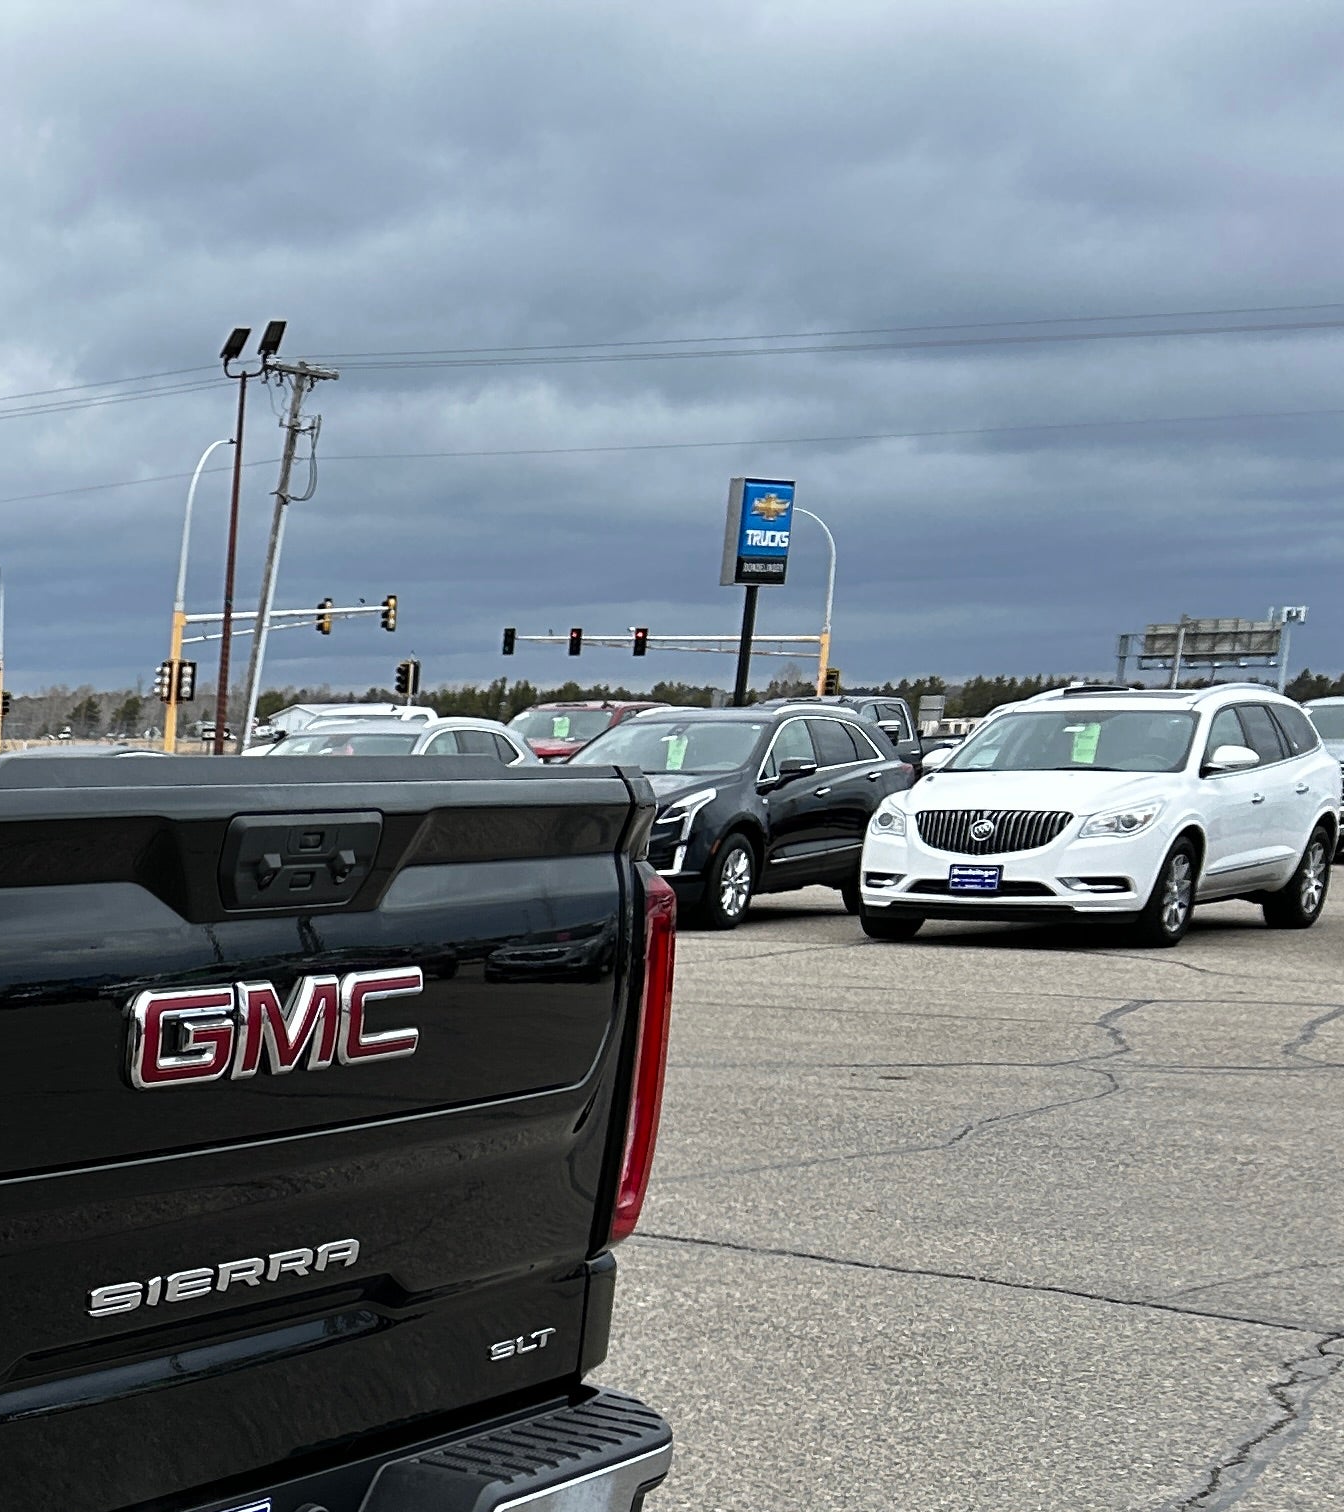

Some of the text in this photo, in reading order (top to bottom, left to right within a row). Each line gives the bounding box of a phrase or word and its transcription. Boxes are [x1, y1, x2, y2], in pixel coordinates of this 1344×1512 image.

[746, 529, 789, 547] TRUCKS
[126, 966, 424, 1092] GMC
[88, 1238, 361, 1318] SIERRA
[489, 1327, 556, 1362] SLT
